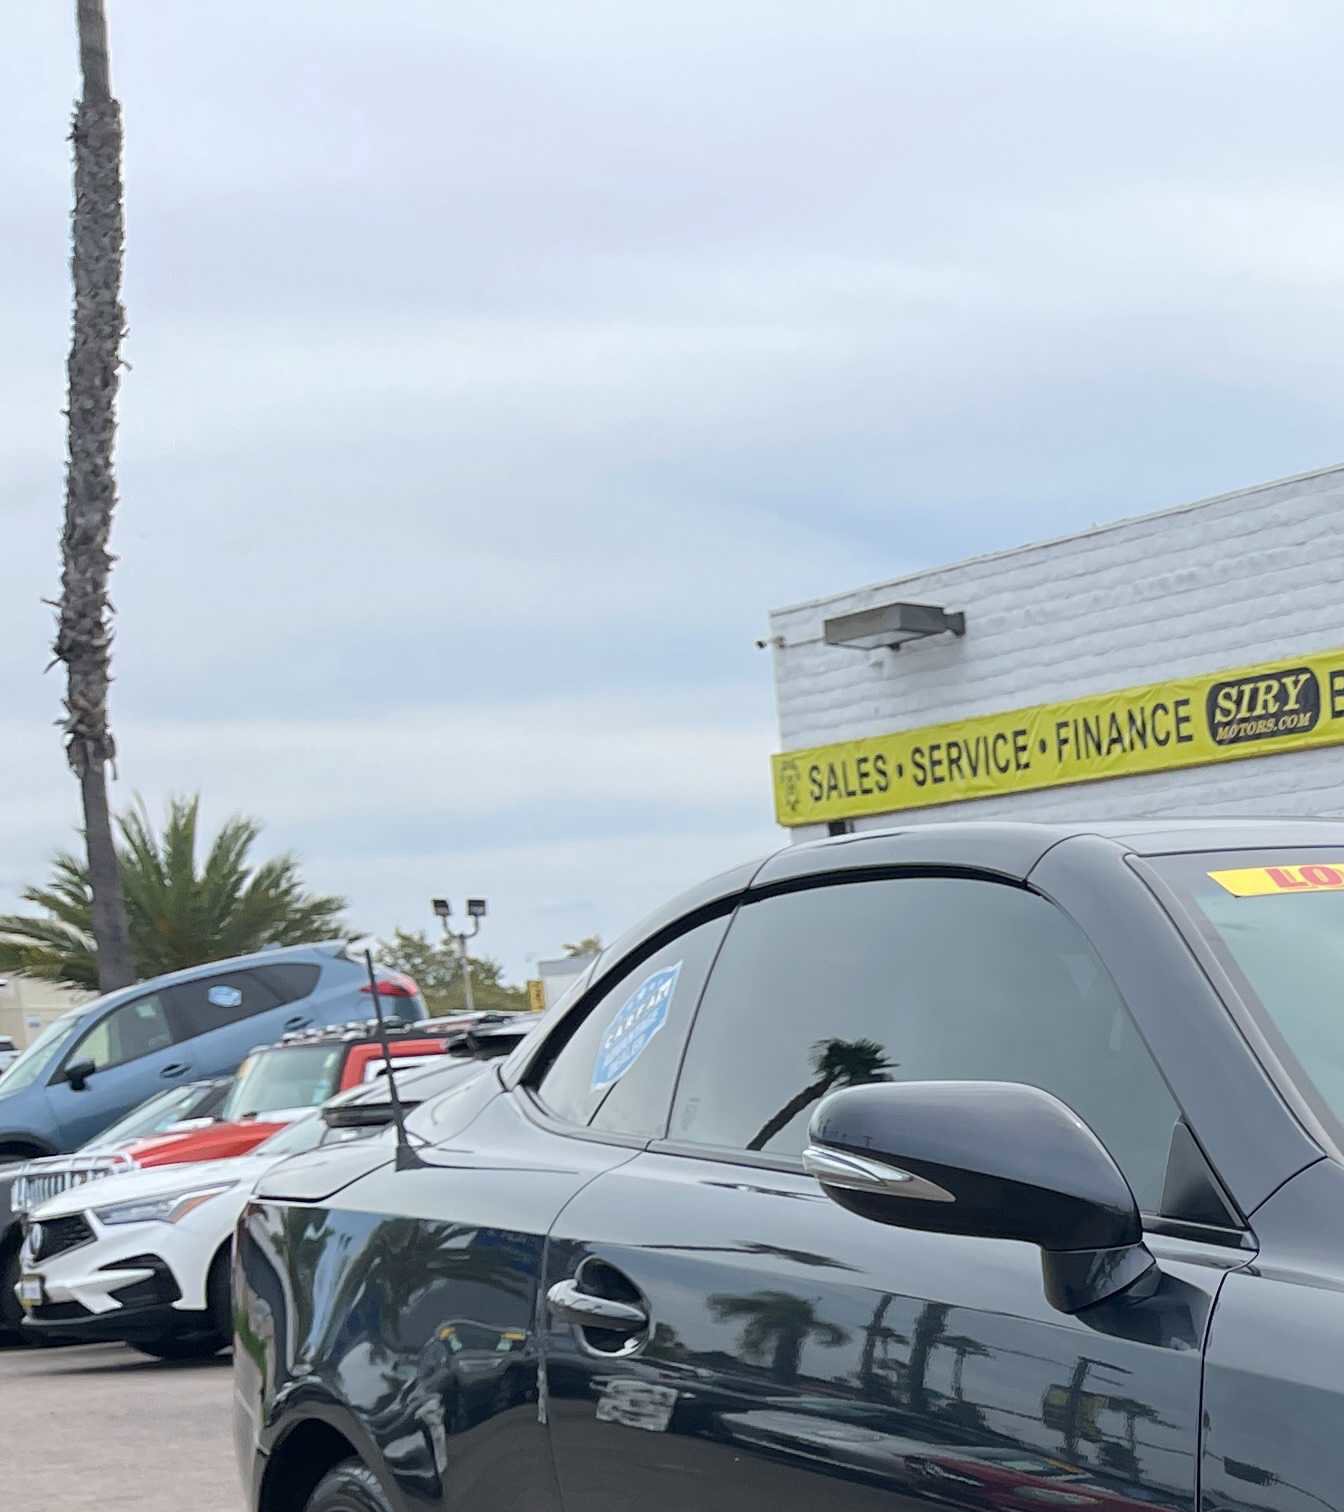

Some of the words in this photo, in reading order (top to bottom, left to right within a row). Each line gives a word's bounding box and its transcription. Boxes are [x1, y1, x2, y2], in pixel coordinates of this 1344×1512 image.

[1214, 673, 1310, 724] SIRY
[808, 753, 889, 802] SALES
[910, 729, 1031, 788] SERVICE
[1055, 699, 1194, 764] FINANCE
[1215, 712, 1312, 741] MOTORS.COM
